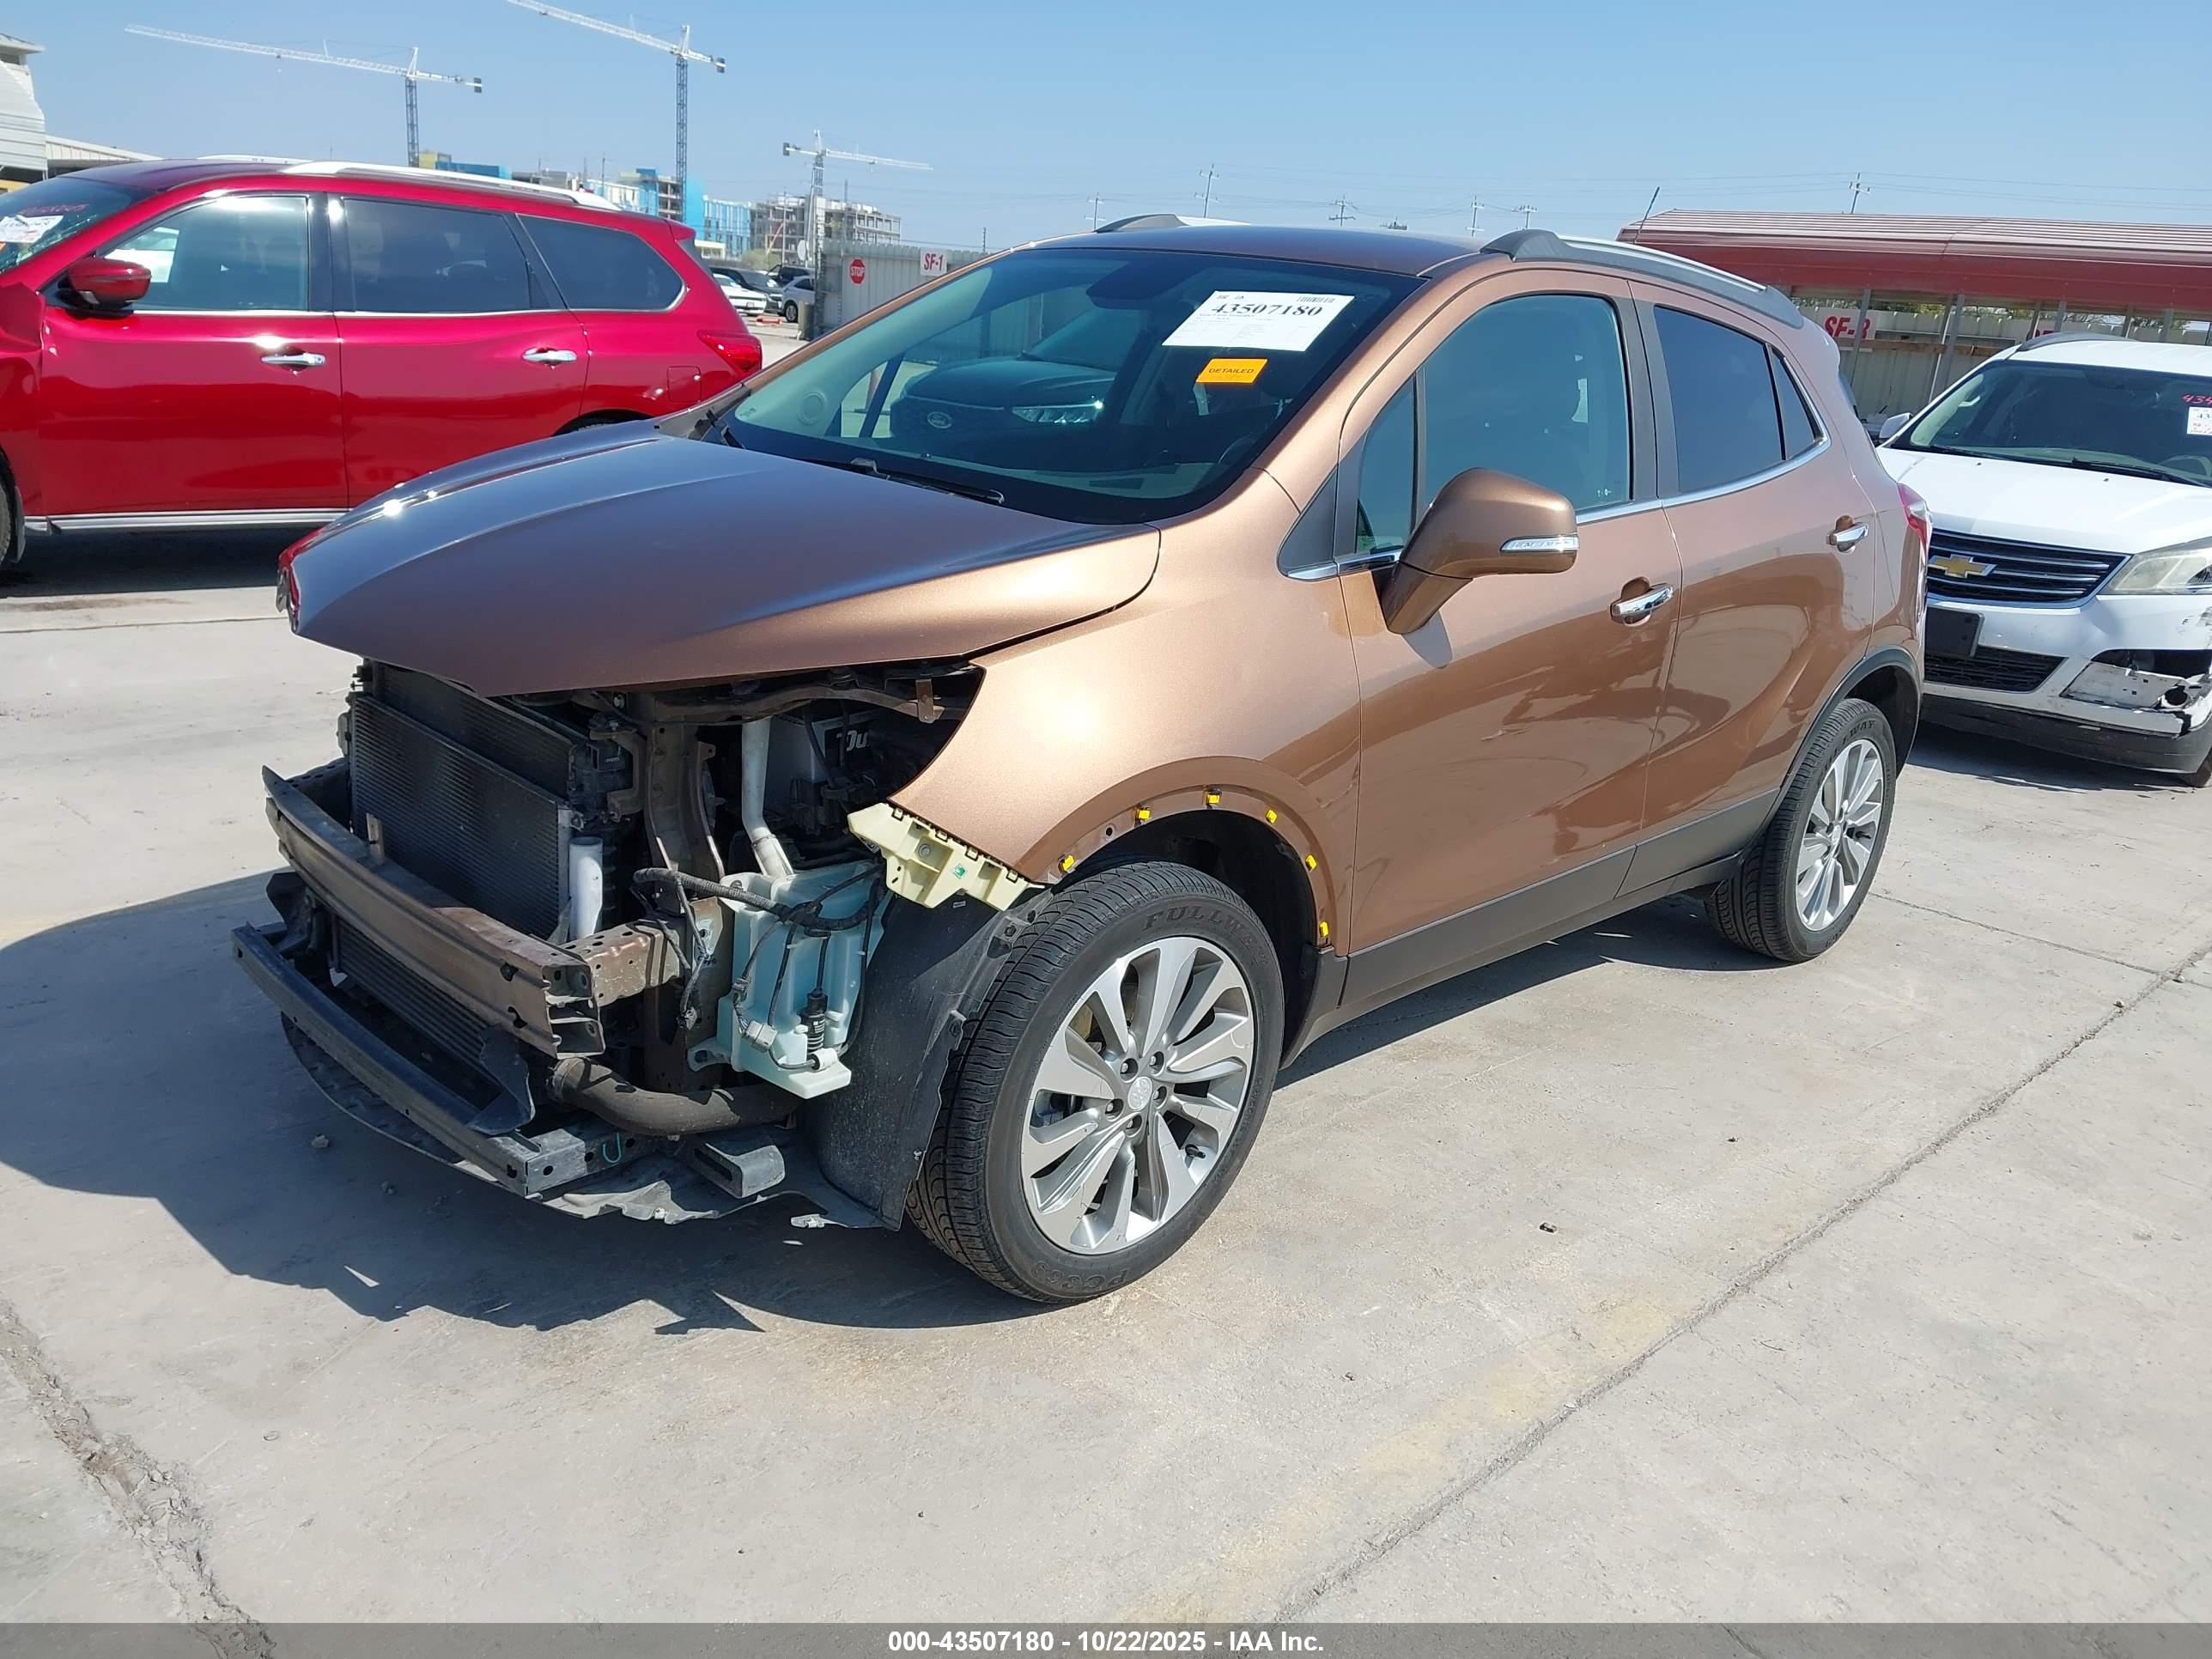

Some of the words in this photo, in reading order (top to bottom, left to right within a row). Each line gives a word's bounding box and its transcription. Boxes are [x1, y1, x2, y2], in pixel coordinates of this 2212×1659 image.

[923, 252, 944, 271] SF-1
[850, 265, 866, 277] STOP
[1212, 302, 1323, 317] 43507180
